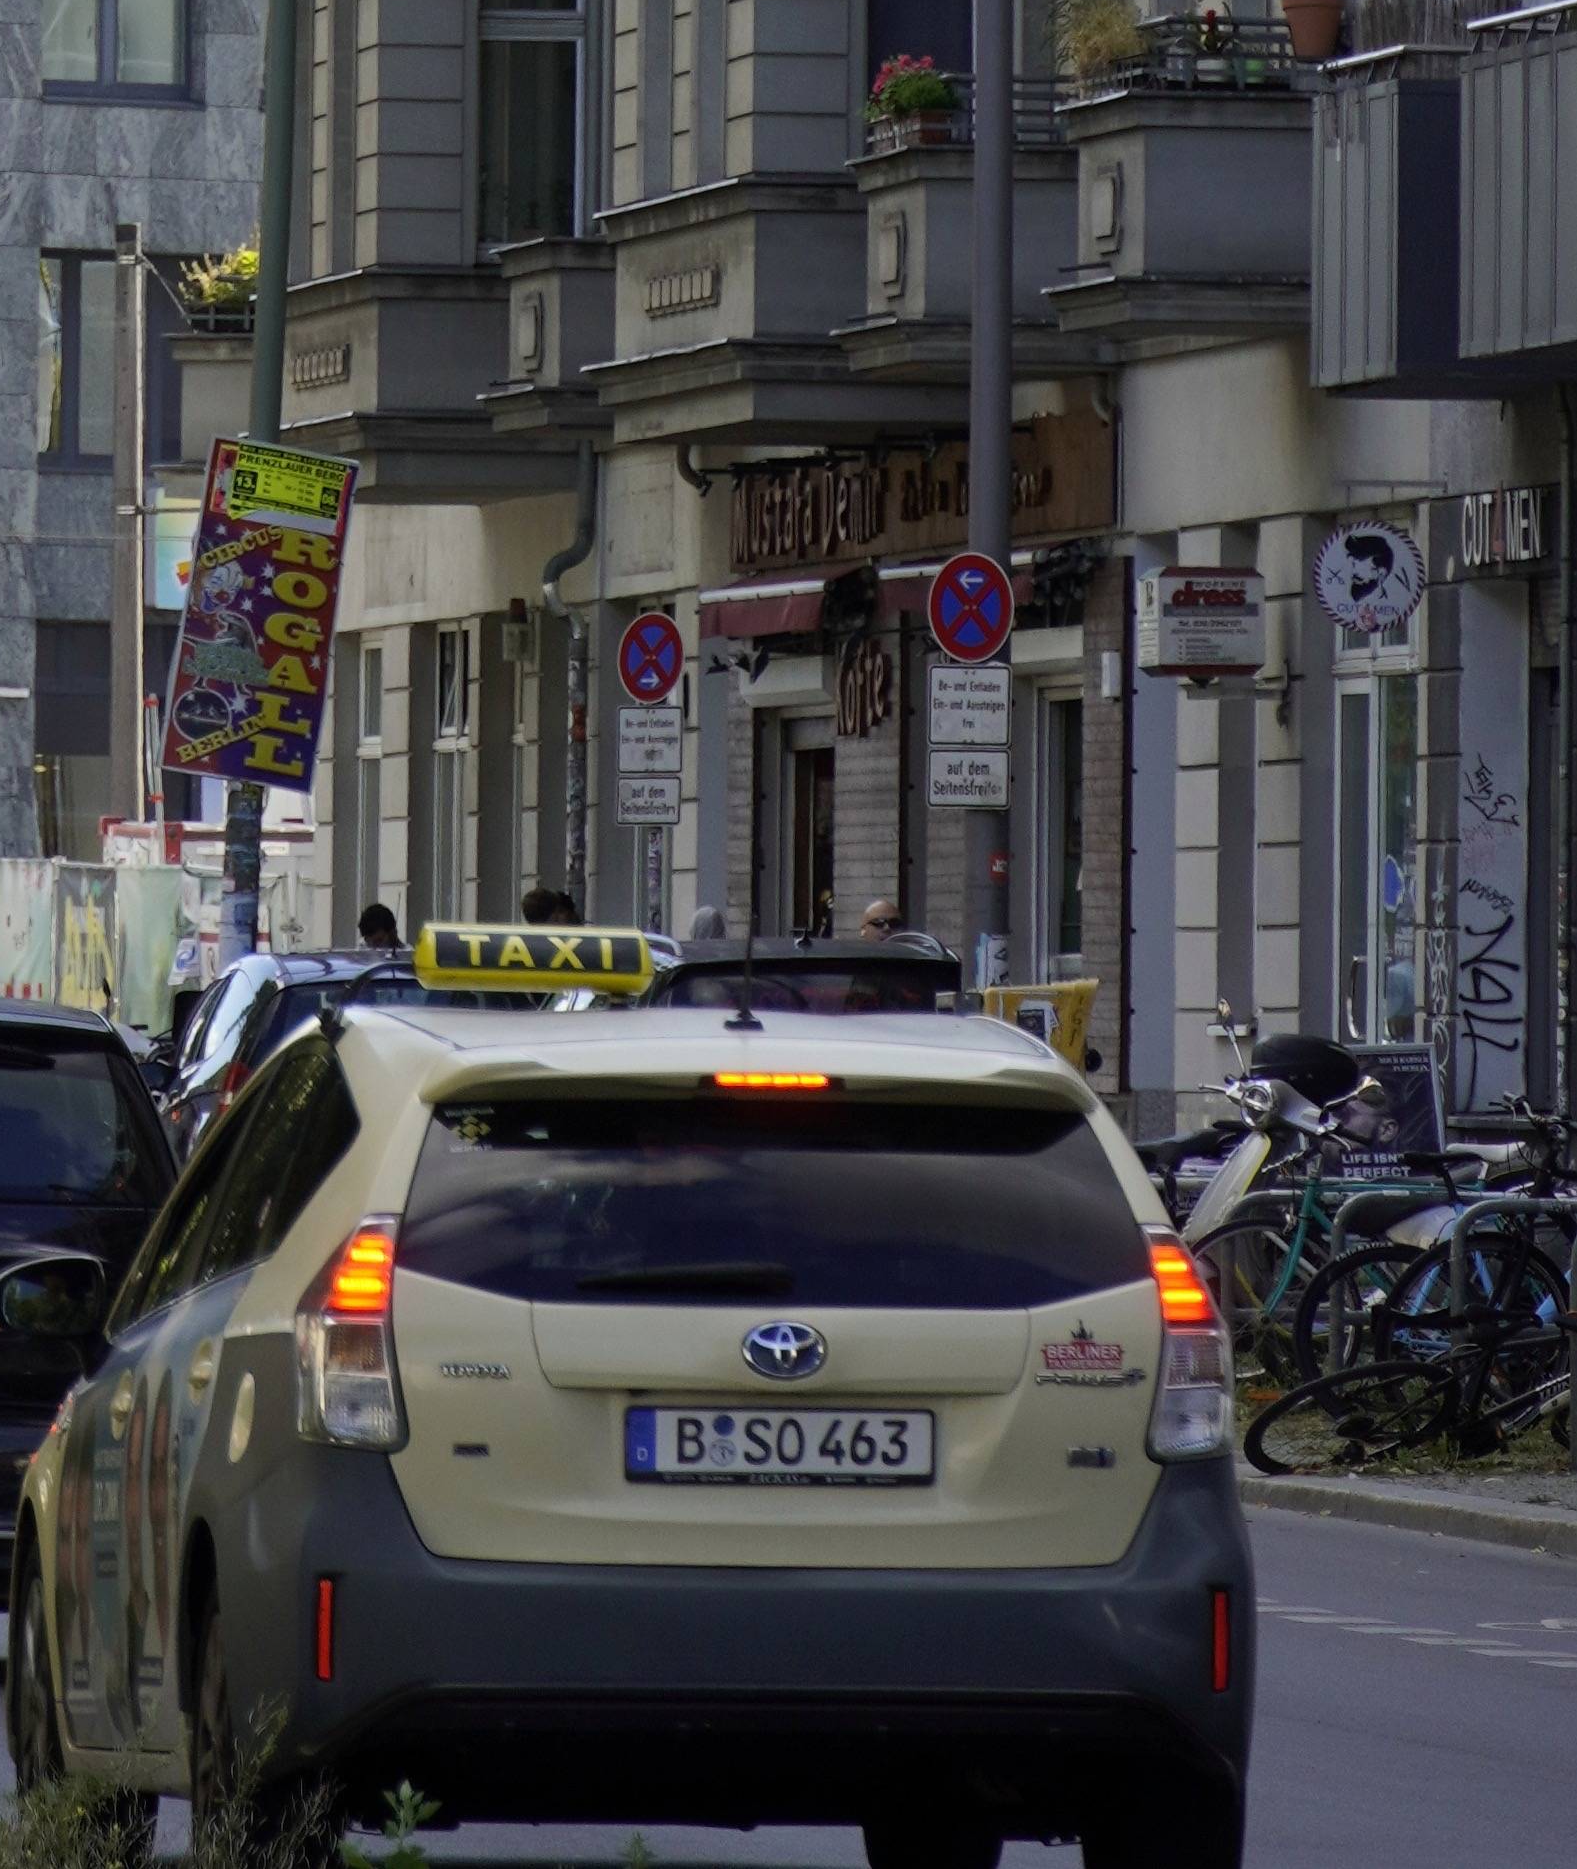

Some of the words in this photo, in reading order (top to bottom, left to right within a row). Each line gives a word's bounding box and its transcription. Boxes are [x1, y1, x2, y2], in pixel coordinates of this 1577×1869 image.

[238, 452, 313, 475] PRENZLAUER
[315, 468, 345, 483] BERG
[199, 525, 283, 569] CIRCUS
[1171, 580, 1247, 606] dress
[243, 528, 339, 777] ROGALL
[176, 712, 268, 763] BERLIN
[946, 759, 963, 776] auf
[968, 760, 990, 776] dem
[458, 934, 614, 970] TAXI
[1341, 1153, 1370, 1164] LIFE
[1343, 1166, 1412, 1178] PERFECT
[1046, 1344, 1121, 1359] BERLINER
[440, 1362, 511, 1380] TOYOTA
[677, 1417, 706, 1465] B
[743, 1417, 806, 1466] SO
[819, 1419, 909, 1467] 463
